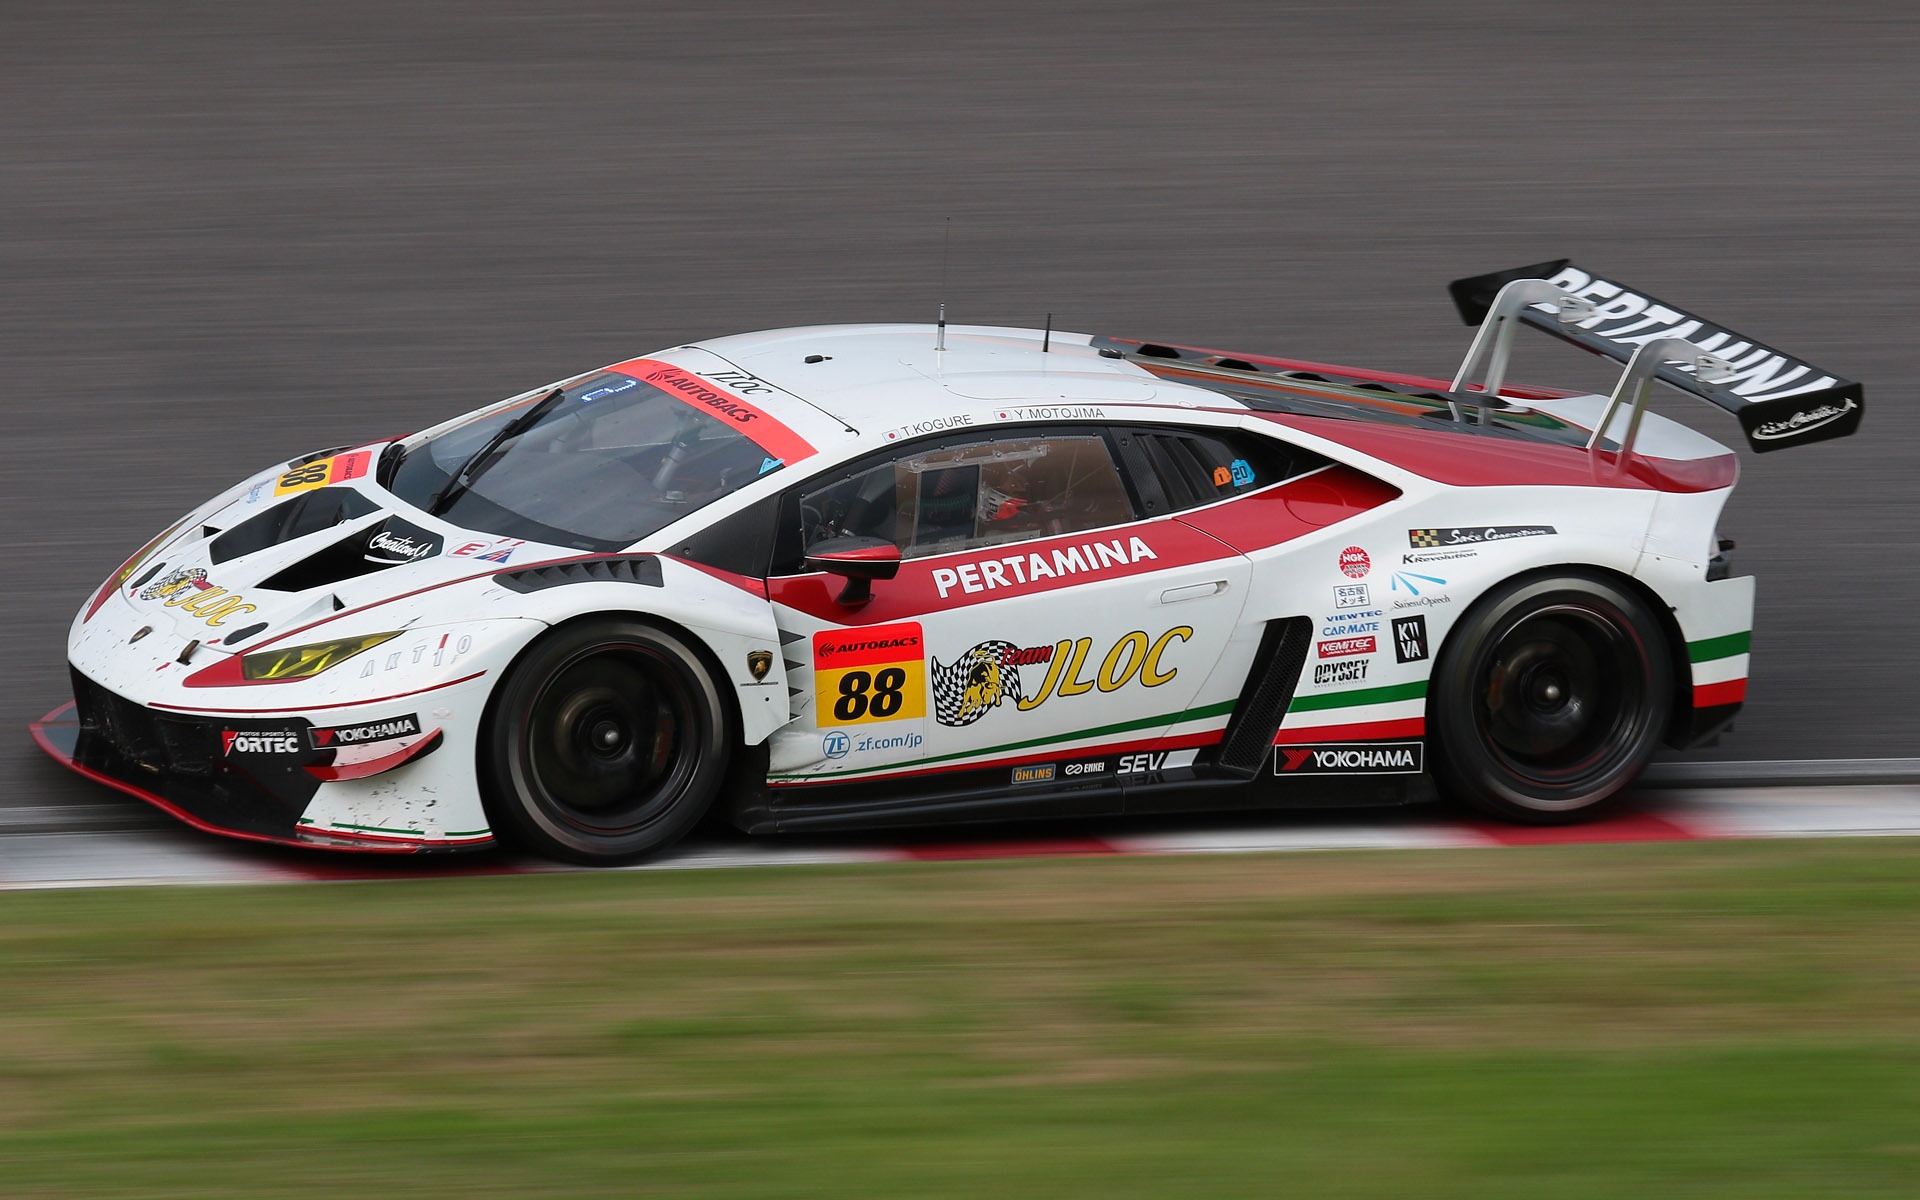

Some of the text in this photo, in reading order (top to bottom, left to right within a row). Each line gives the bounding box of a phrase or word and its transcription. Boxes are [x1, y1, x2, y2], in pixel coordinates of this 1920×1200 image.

[695, 371, 774, 395] JLOC
[667, 377, 758, 423] AUTOBACS
[1014, 407, 1105, 421] Y.MOTOJIMA
[900, 414, 974, 437] T.KOGURE
[280, 463, 328, 488] 88
[1232, 465, 1249, 480] 20
[452, 543, 486, 555] E
[1343, 552, 1366, 563] NGK
[932, 536, 1158, 599] PERTAMINA
[1338, 586, 1365, 597] 名古屋
[1340, 595, 1367, 606] メッキ
[163, 585, 257, 627] JLOC
[1326, 610, 1383, 622] VIEWTEC
[1322, 622, 1380, 637] CARMATE
[359, 633, 472, 679] AKTIO
[836, 636, 919, 654] AUTOBACS
[1017, 625, 1194, 711] JLOC
[1314, 659, 1370, 685] ODYSSEY
[833, 667, 906, 721] 88
[334, 719, 416, 743] YOKOHAMA
[825, 733, 923, 757] ZF zf.com/jp
[1083, 761, 1105, 774] ENKEI
[1117, 752, 1165, 774] SEV
[1312, 749, 1415, 768] YOKOHAMA
[1015, 768, 1053, 782] ÖHLINS
